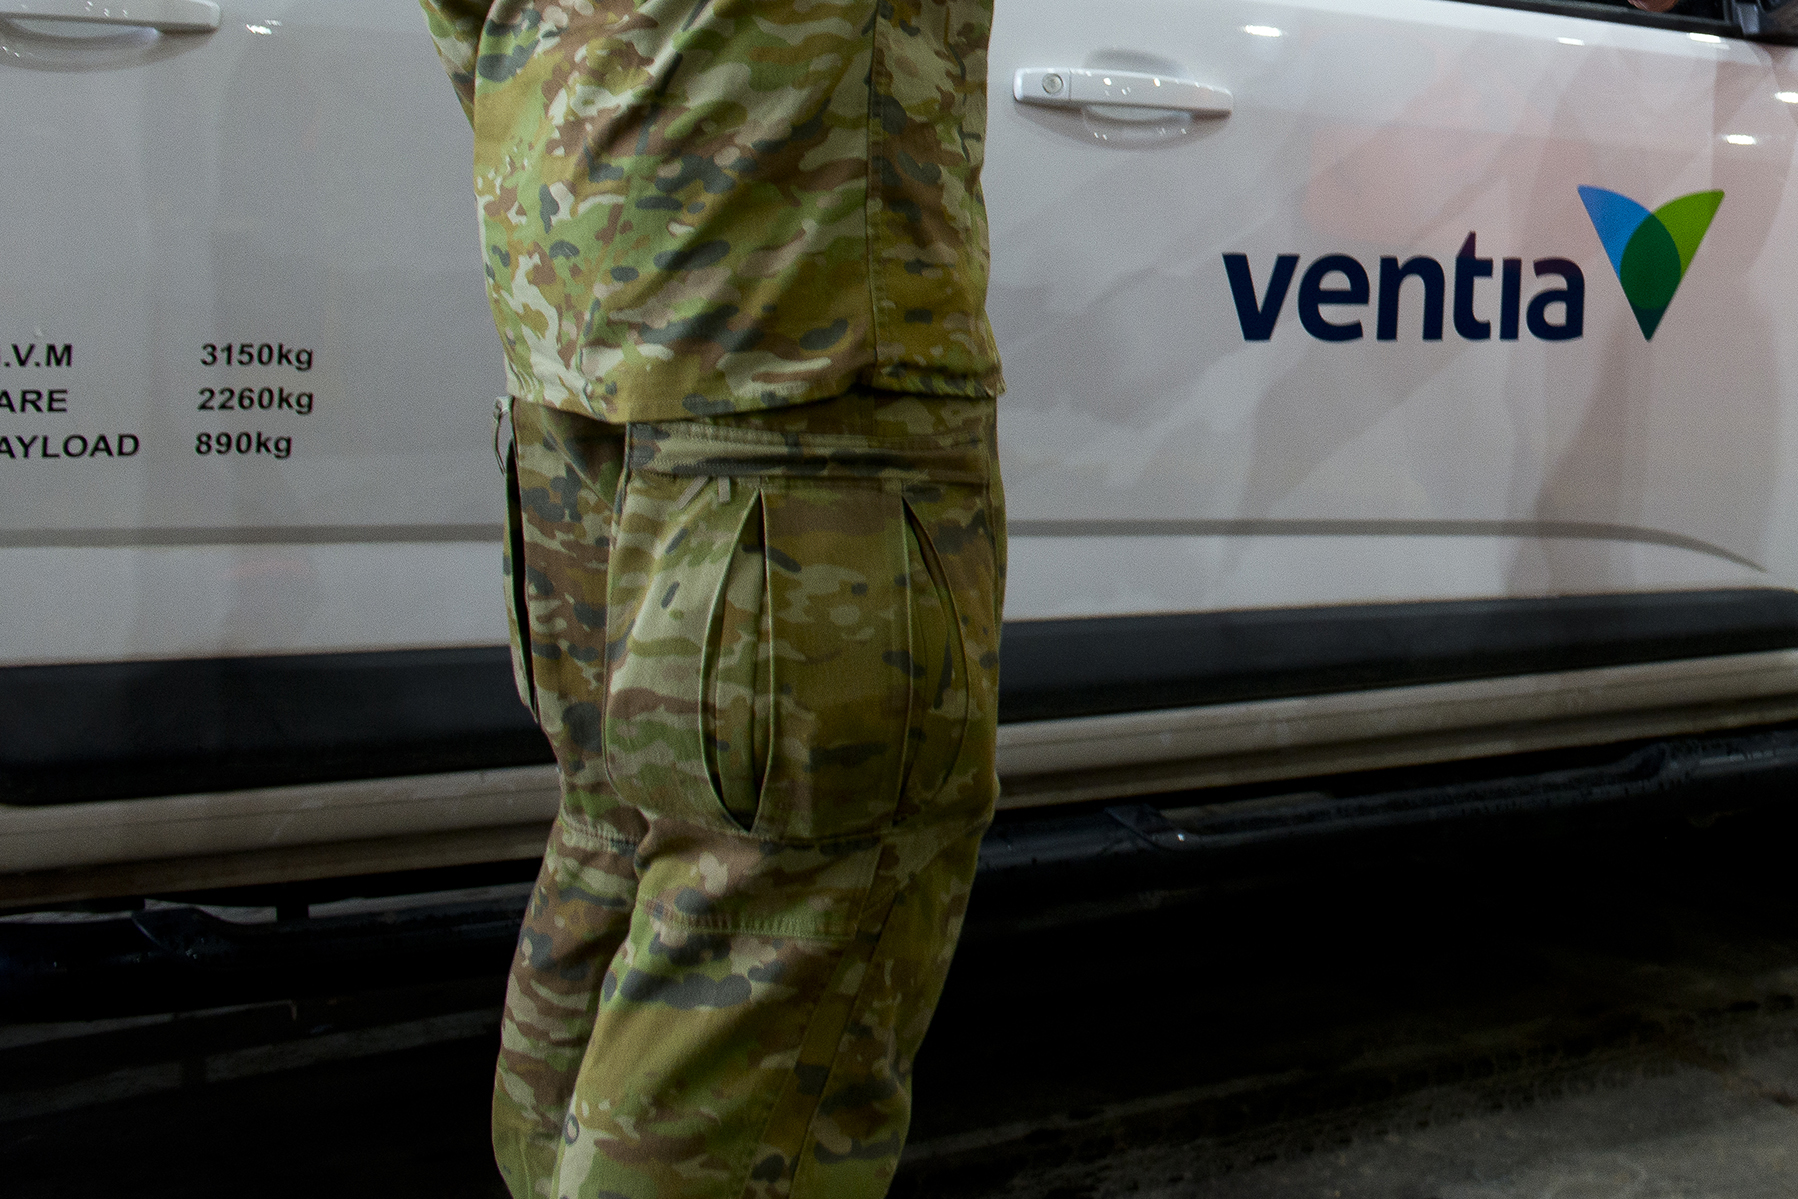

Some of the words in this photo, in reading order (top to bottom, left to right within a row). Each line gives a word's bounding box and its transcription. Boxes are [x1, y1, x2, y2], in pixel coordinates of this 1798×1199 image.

[1222, 231, 1585, 342] ventia
[0, 343, 73, 367] .V.M
[200, 343, 314, 371] 3150kg
[197, 387, 314, 415] 2260kg
[0, 433, 140, 459] AYLOAD
[194, 431, 292, 459] 890kg
